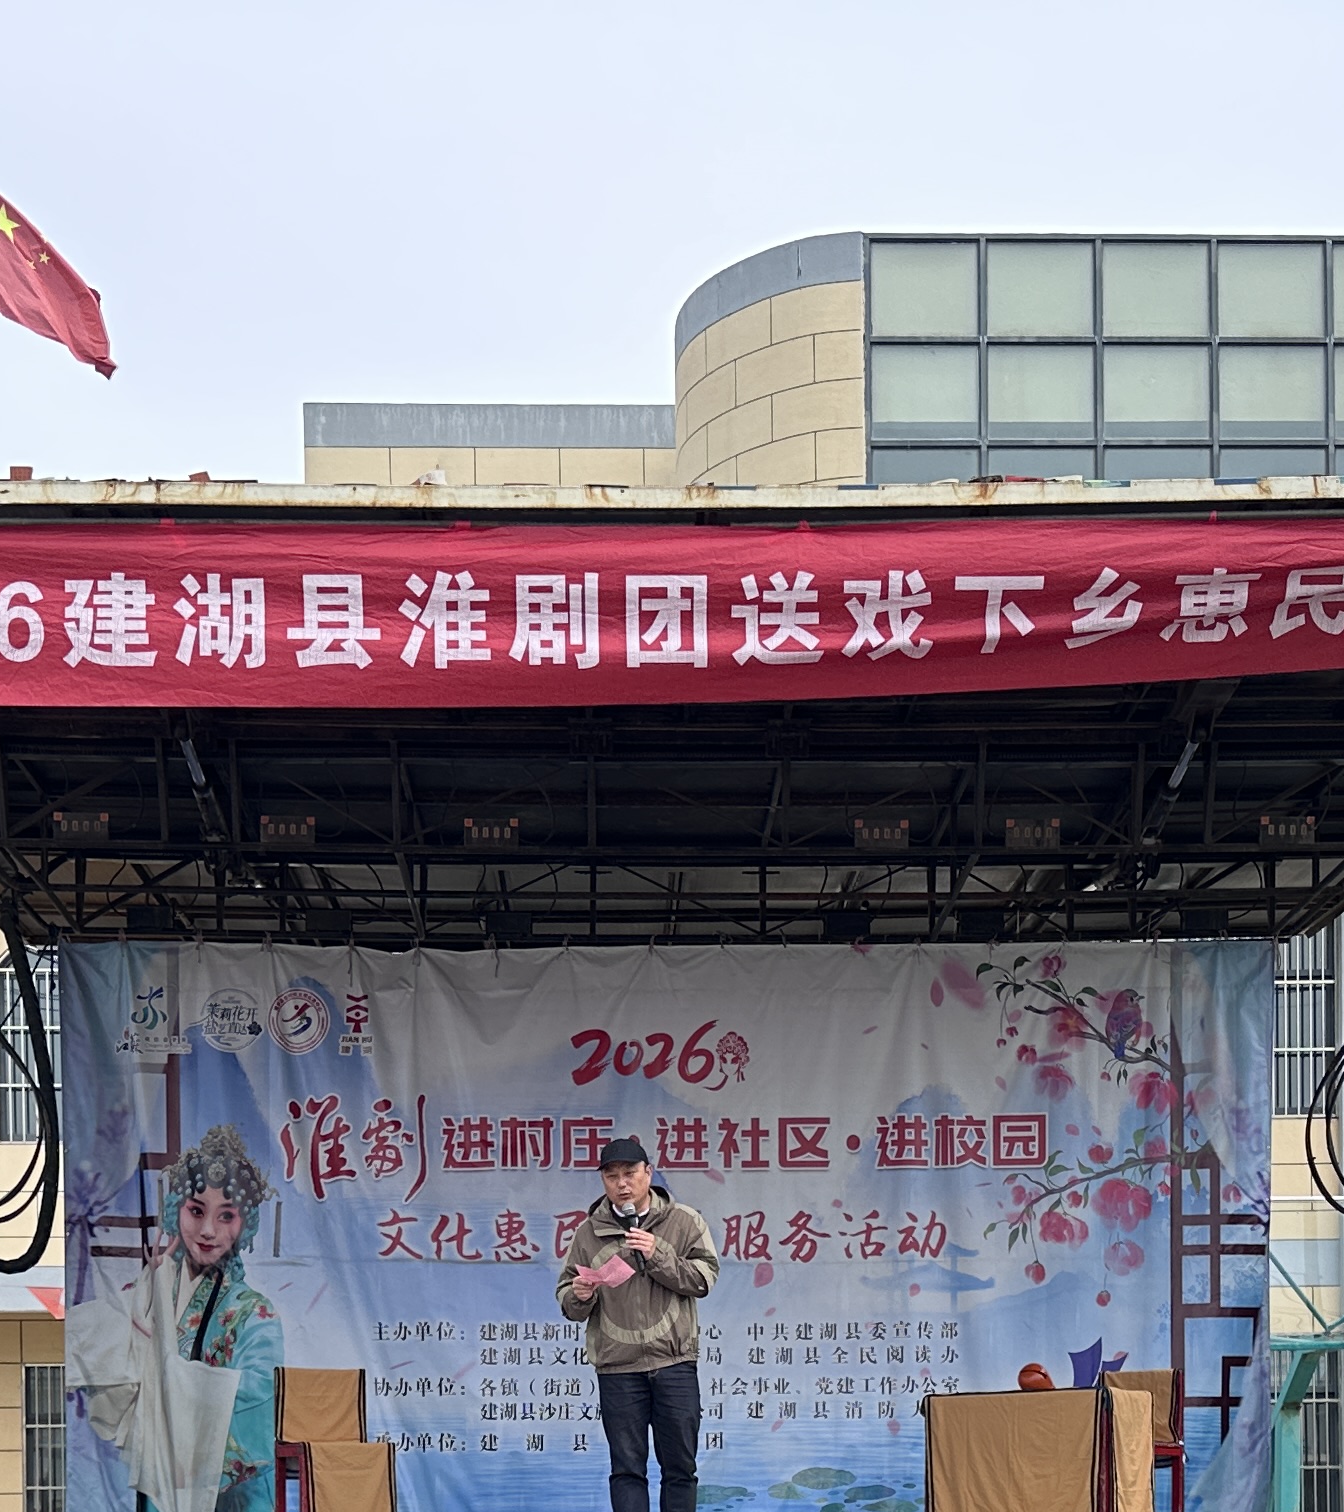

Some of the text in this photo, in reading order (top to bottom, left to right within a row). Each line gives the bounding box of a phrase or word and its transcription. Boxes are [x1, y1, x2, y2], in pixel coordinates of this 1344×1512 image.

[569, 1019, 719, 1087] 2026
[721, 1210, 948, 1263] 服务活动
[479, 1321, 587, 1342] 建湖县新时
[747, 1321, 959, 1341] 中共建湖县委宣传部
[747, 1345, 959, 1365] 建湖县全民阅读办
[705, 1431, 724, 1450] 团
